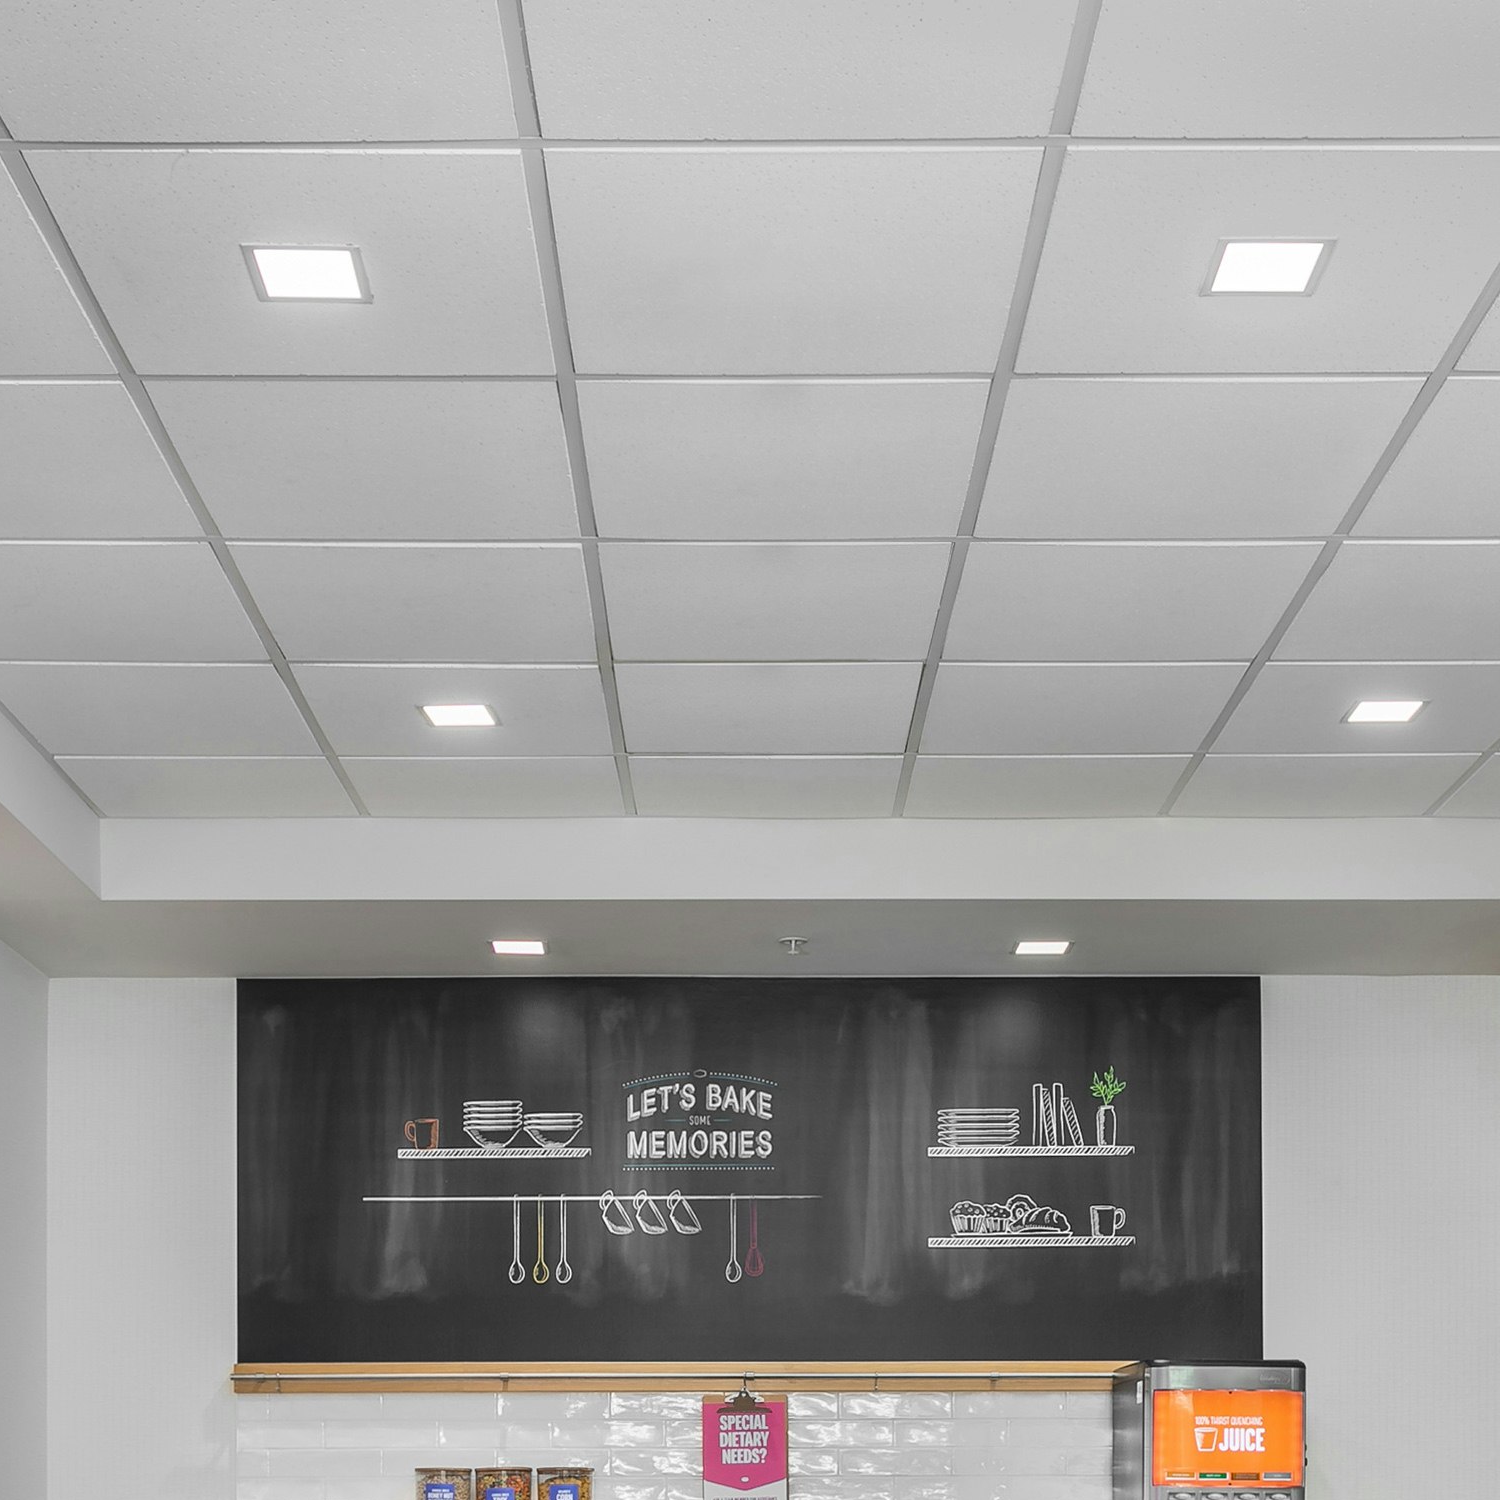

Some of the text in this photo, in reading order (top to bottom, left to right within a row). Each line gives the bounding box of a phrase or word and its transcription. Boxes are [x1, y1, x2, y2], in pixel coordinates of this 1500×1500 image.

[627, 1083, 773, 1122] LET'S BAKE
[688, 1115, 711, 1126] SOME
[627, 1129, 773, 1159] MEMORIES
[719, 1414, 769, 1430] SPECIAL
[1195, 1416, 1210, 1425] 100%
[1210, 1416, 1230, 1425] THIRST
[719, 1431, 770, 1447] DIETARY
[1218, 1427, 1266, 1452] JUICE
[721, 1448, 767, 1464] NEEDS?
[556, 1493, 573, 1500] CORN
